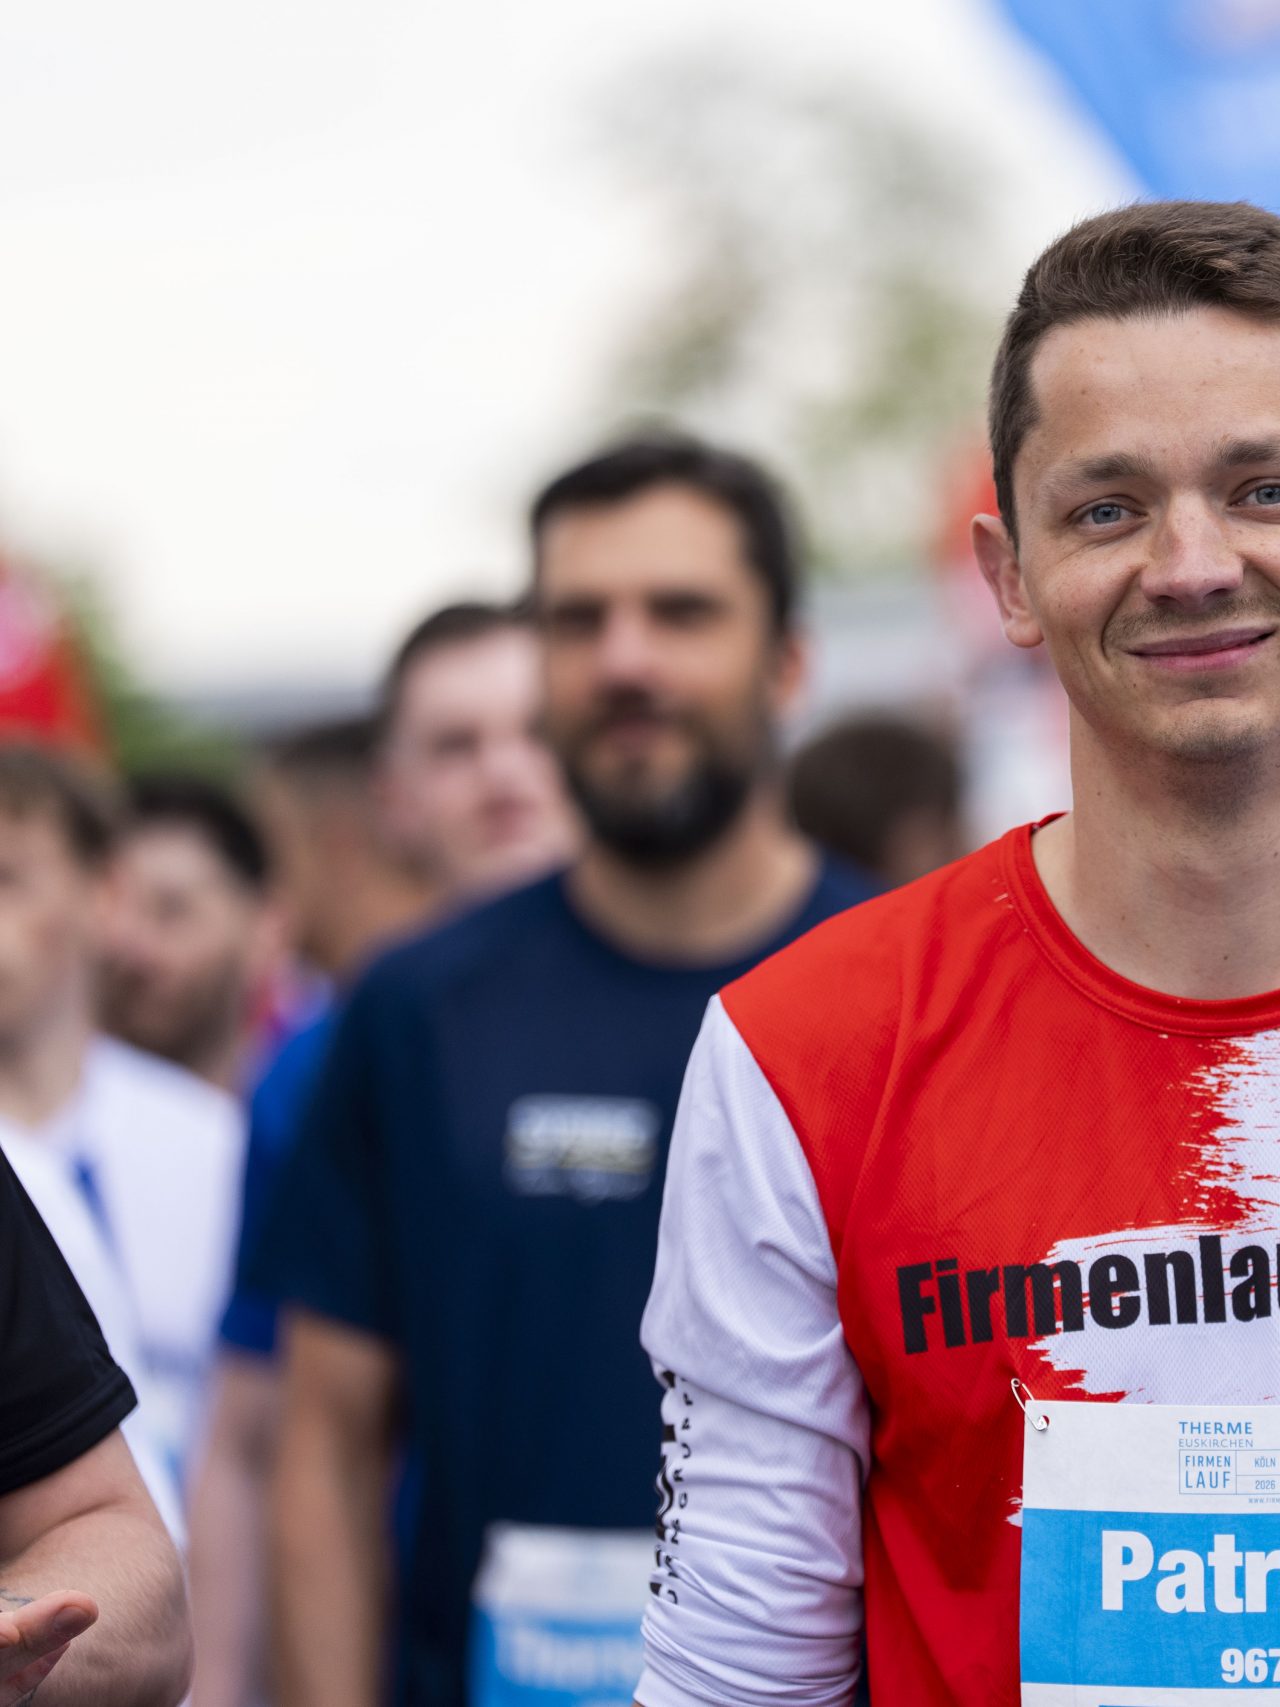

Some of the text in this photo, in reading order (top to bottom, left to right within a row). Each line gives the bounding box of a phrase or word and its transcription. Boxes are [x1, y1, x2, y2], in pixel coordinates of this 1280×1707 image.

[1178, 1421, 1254, 1435] THERME
[1178, 1438, 1254, 1448] EUSKIRCHEN
[1185, 1455, 1231, 1468] FIRMEN
[1254, 1456, 1276, 1468] KÖLN
[1185, 1471, 1231, 1489] LAUF
[1255, 1480, 1276, 1490] 2026
